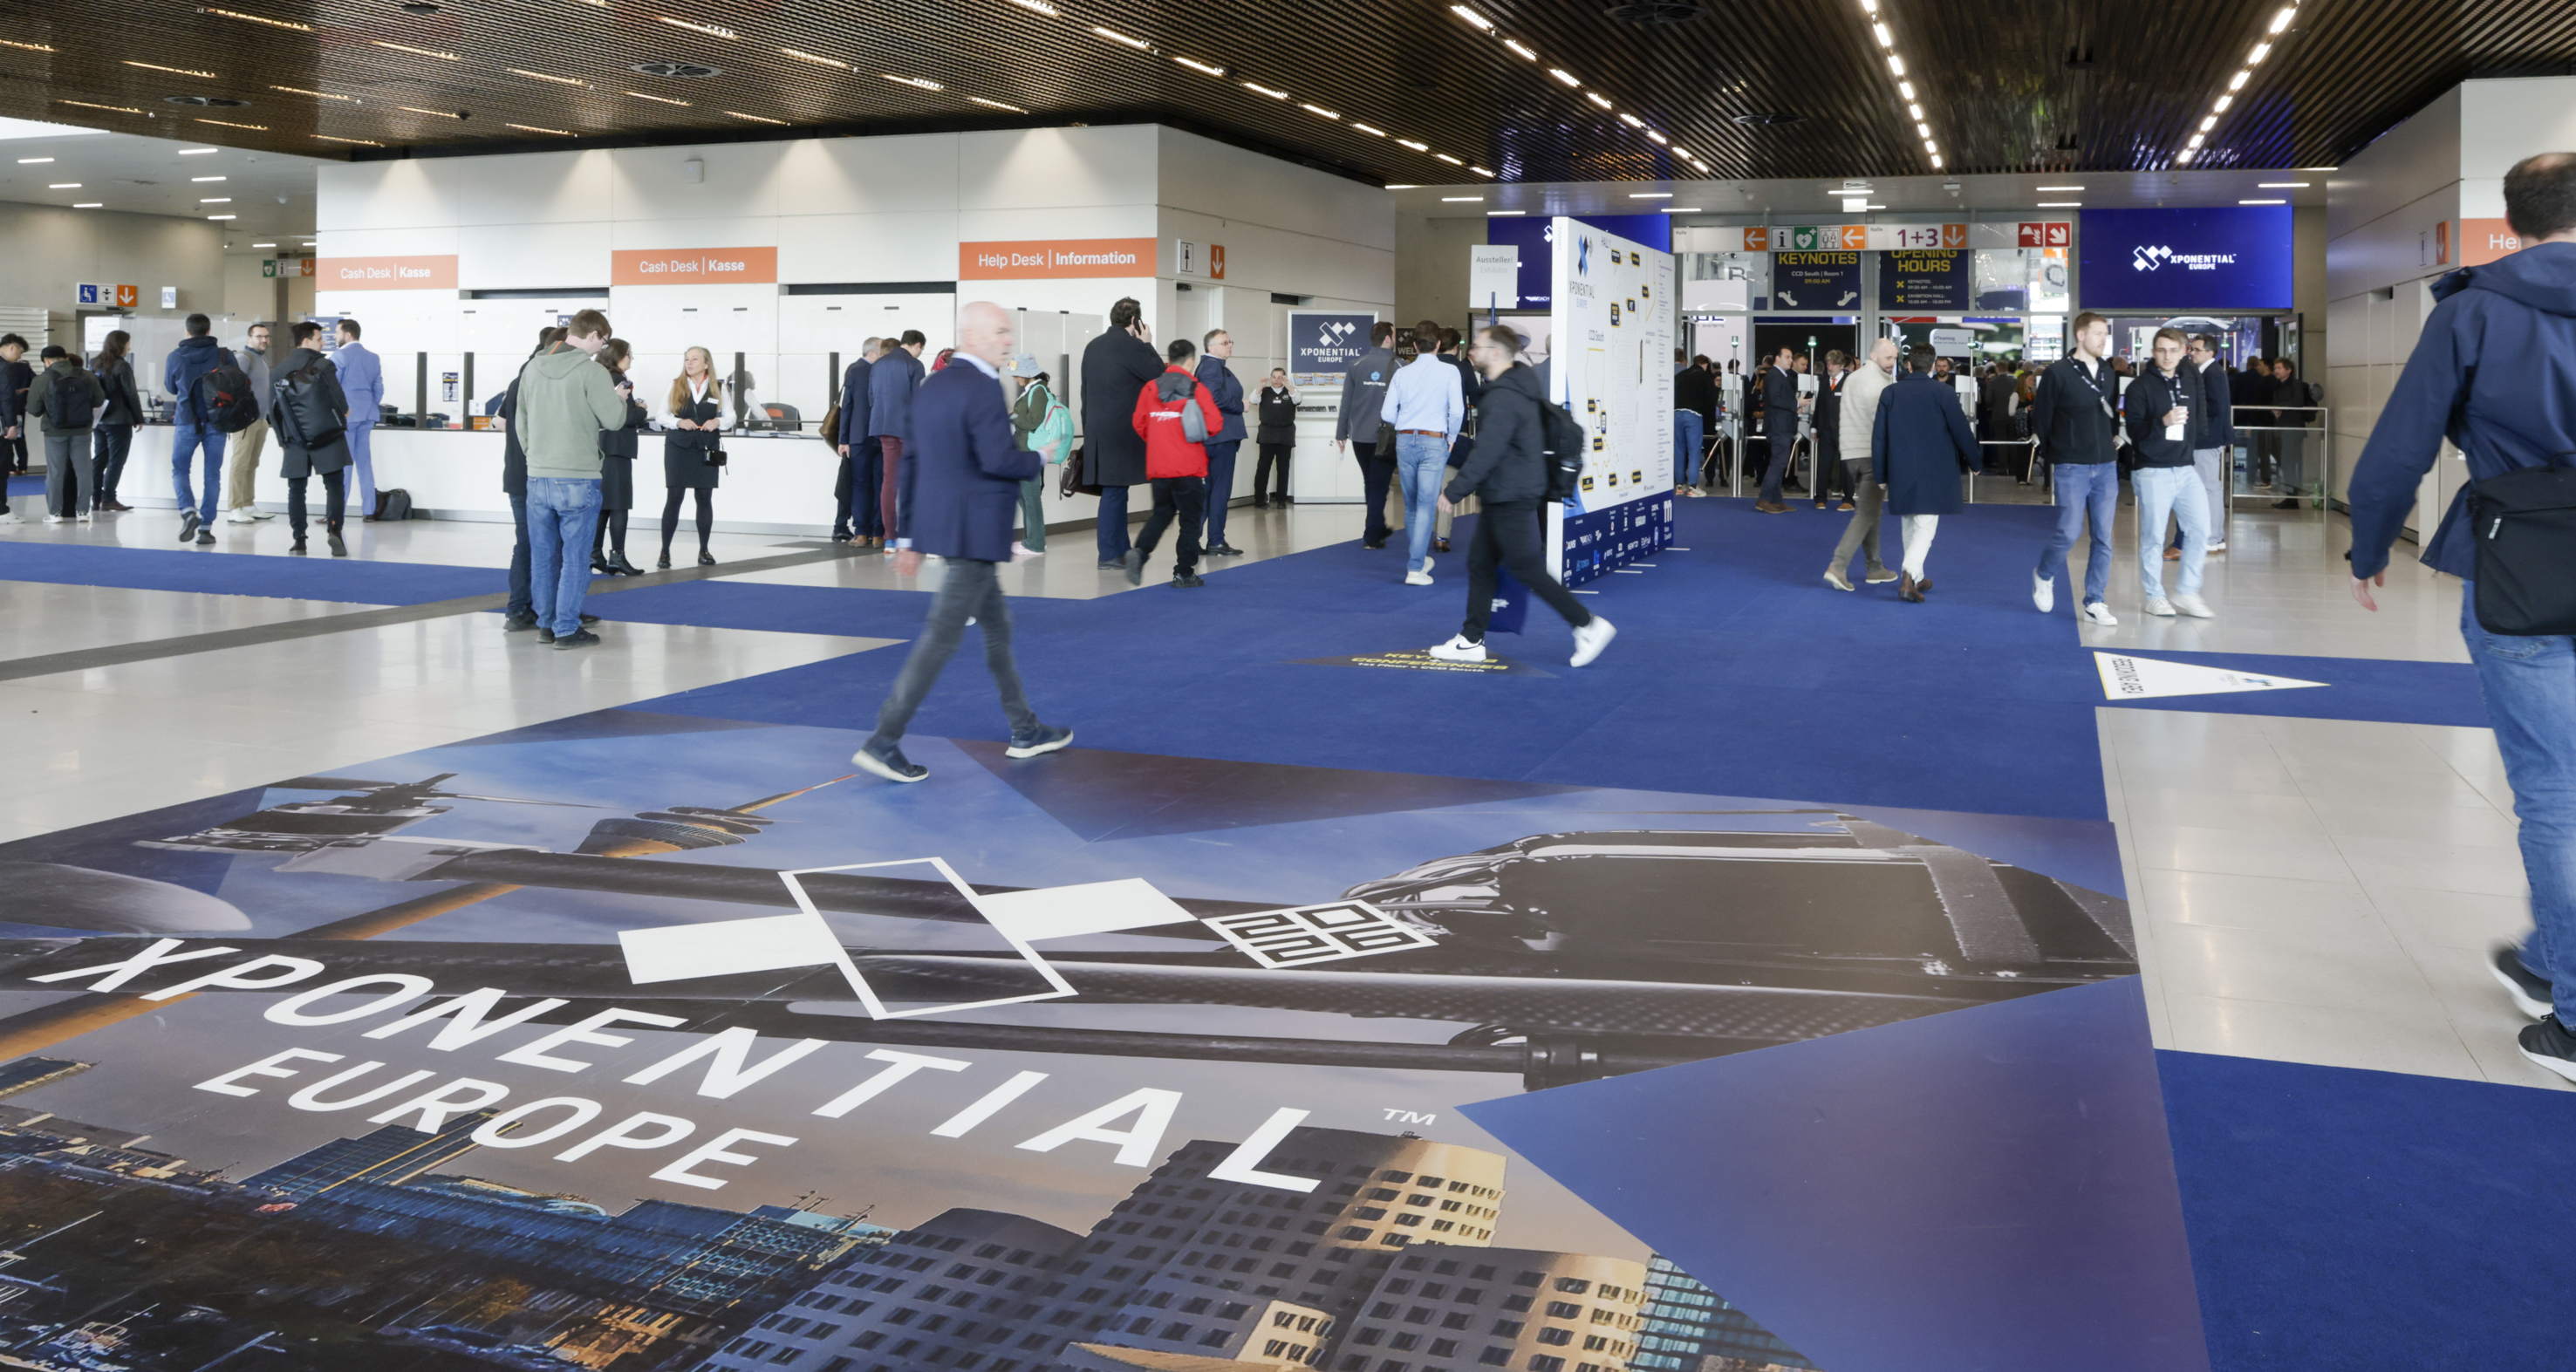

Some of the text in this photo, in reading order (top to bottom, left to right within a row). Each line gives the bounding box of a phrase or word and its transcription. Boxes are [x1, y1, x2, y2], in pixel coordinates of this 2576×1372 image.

[1897, 228, 1938, 248] 1+3
[2489, 234, 2522, 250] Hel
[978, 250, 1137, 270] Help Desk Information
[1778, 252, 1858, 265] KEYNOTES
[1891, 249, 1958, 259] OPENING
[2170, 255, 2235, 263] XPONENTIAL
[639, 259, 746, 273] Cash Desk Kasse
[1897, 259, 1951, 272] HOURS
[340, 266, 431, 279] Cash Desk Kasse
[1301, 347, 1361, 357] XPONENTIAL
[1351, 657, 1509, 670] CONFERENCES
[26, 938, 1322, 1194] XPONENTIAL
[191, 1047, 800, 1191] EUROPE
